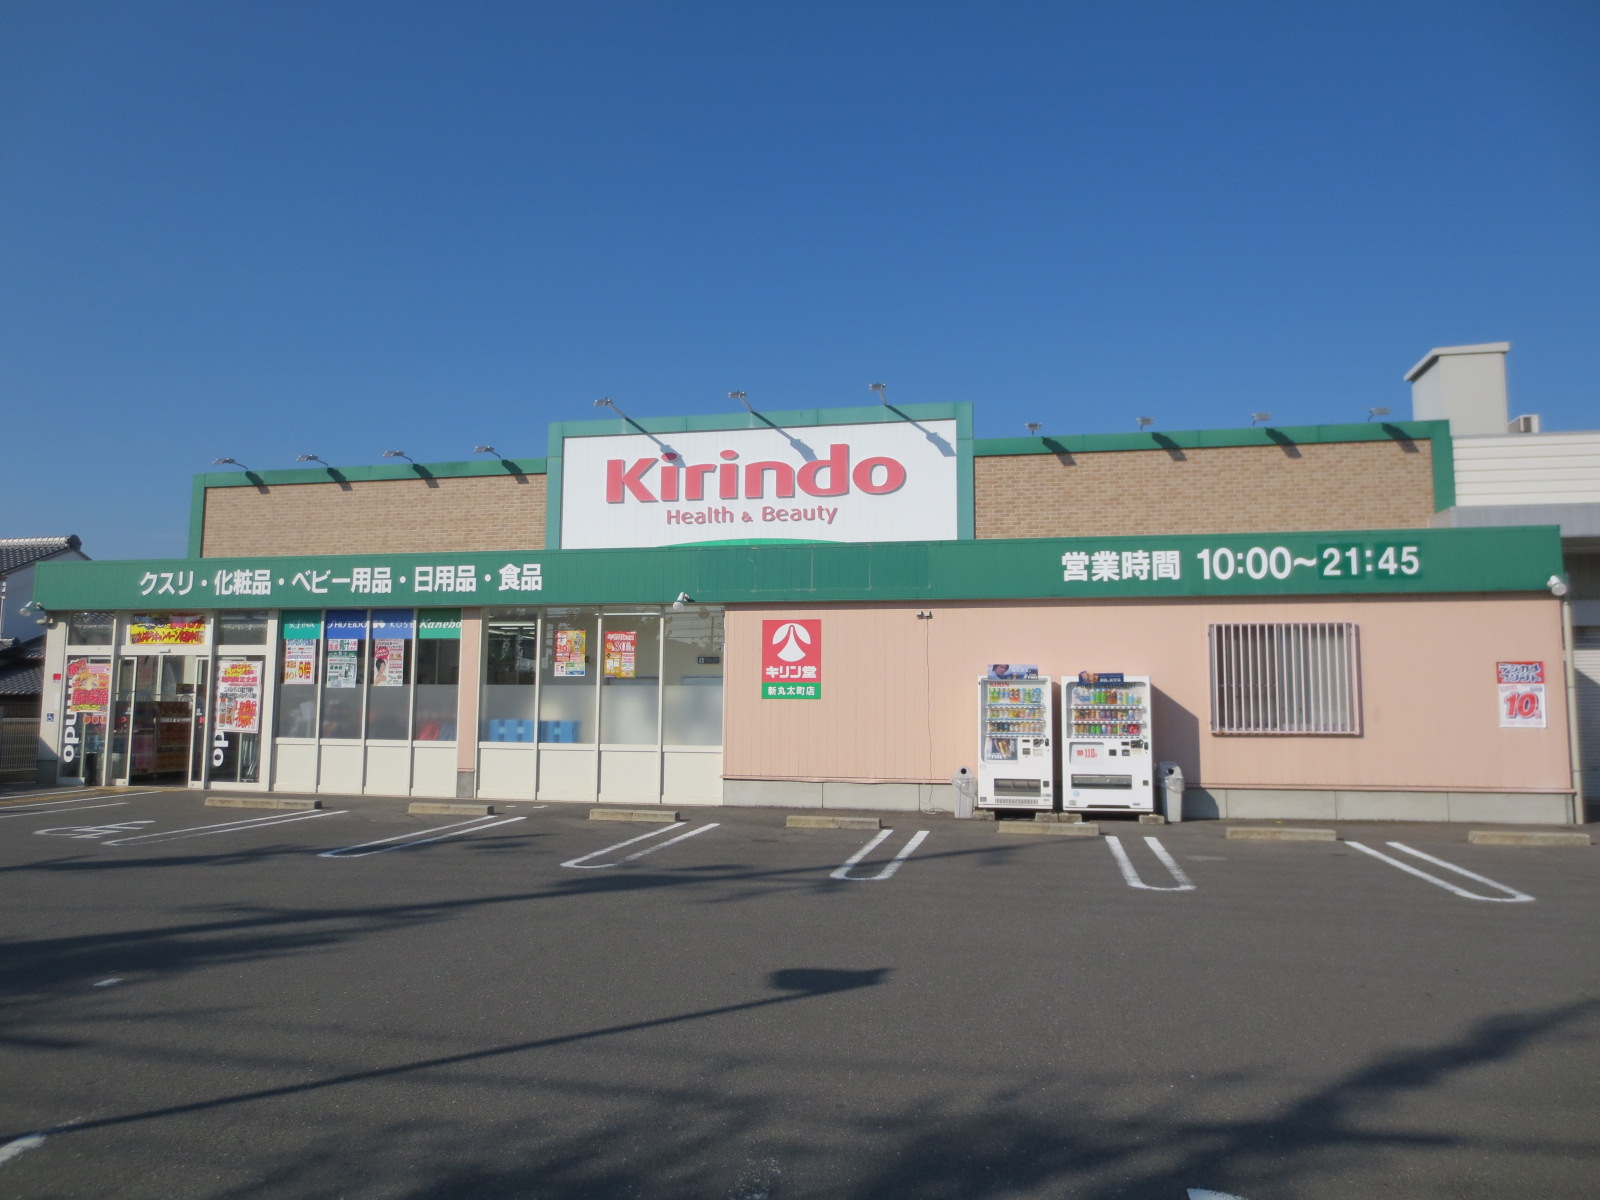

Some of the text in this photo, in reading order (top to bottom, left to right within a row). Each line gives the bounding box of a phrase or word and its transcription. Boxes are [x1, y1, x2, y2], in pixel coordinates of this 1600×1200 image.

[606, 443, 907, 503] Kirindo
[666, 505, 839, 525] Health & Beauty
[1061, 550, 1181, 582] 営業時間
[327, 620, 367, 629] SHISEIDO
[419, 619, 462, 629] Kanebo
[765, 665, 817, 679] キリン堂
[767, 685, 816, 696] 新丸太町店
